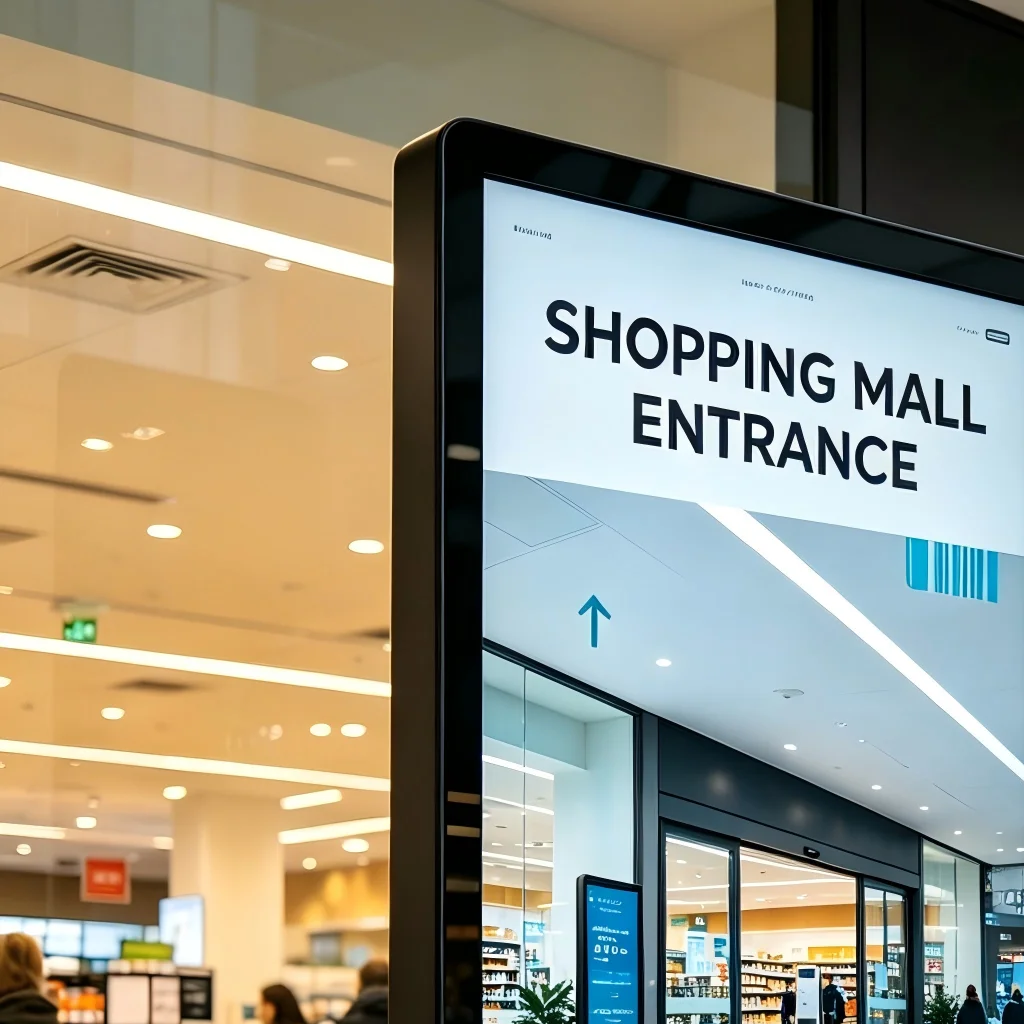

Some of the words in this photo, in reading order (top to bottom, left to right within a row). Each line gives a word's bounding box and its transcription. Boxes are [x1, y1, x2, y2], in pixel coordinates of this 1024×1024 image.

[544, 299, 836, 404] SHOPPING
[853, 360, 987, 435] MALL
[633, 392, 918, 492] ENTRANCE
